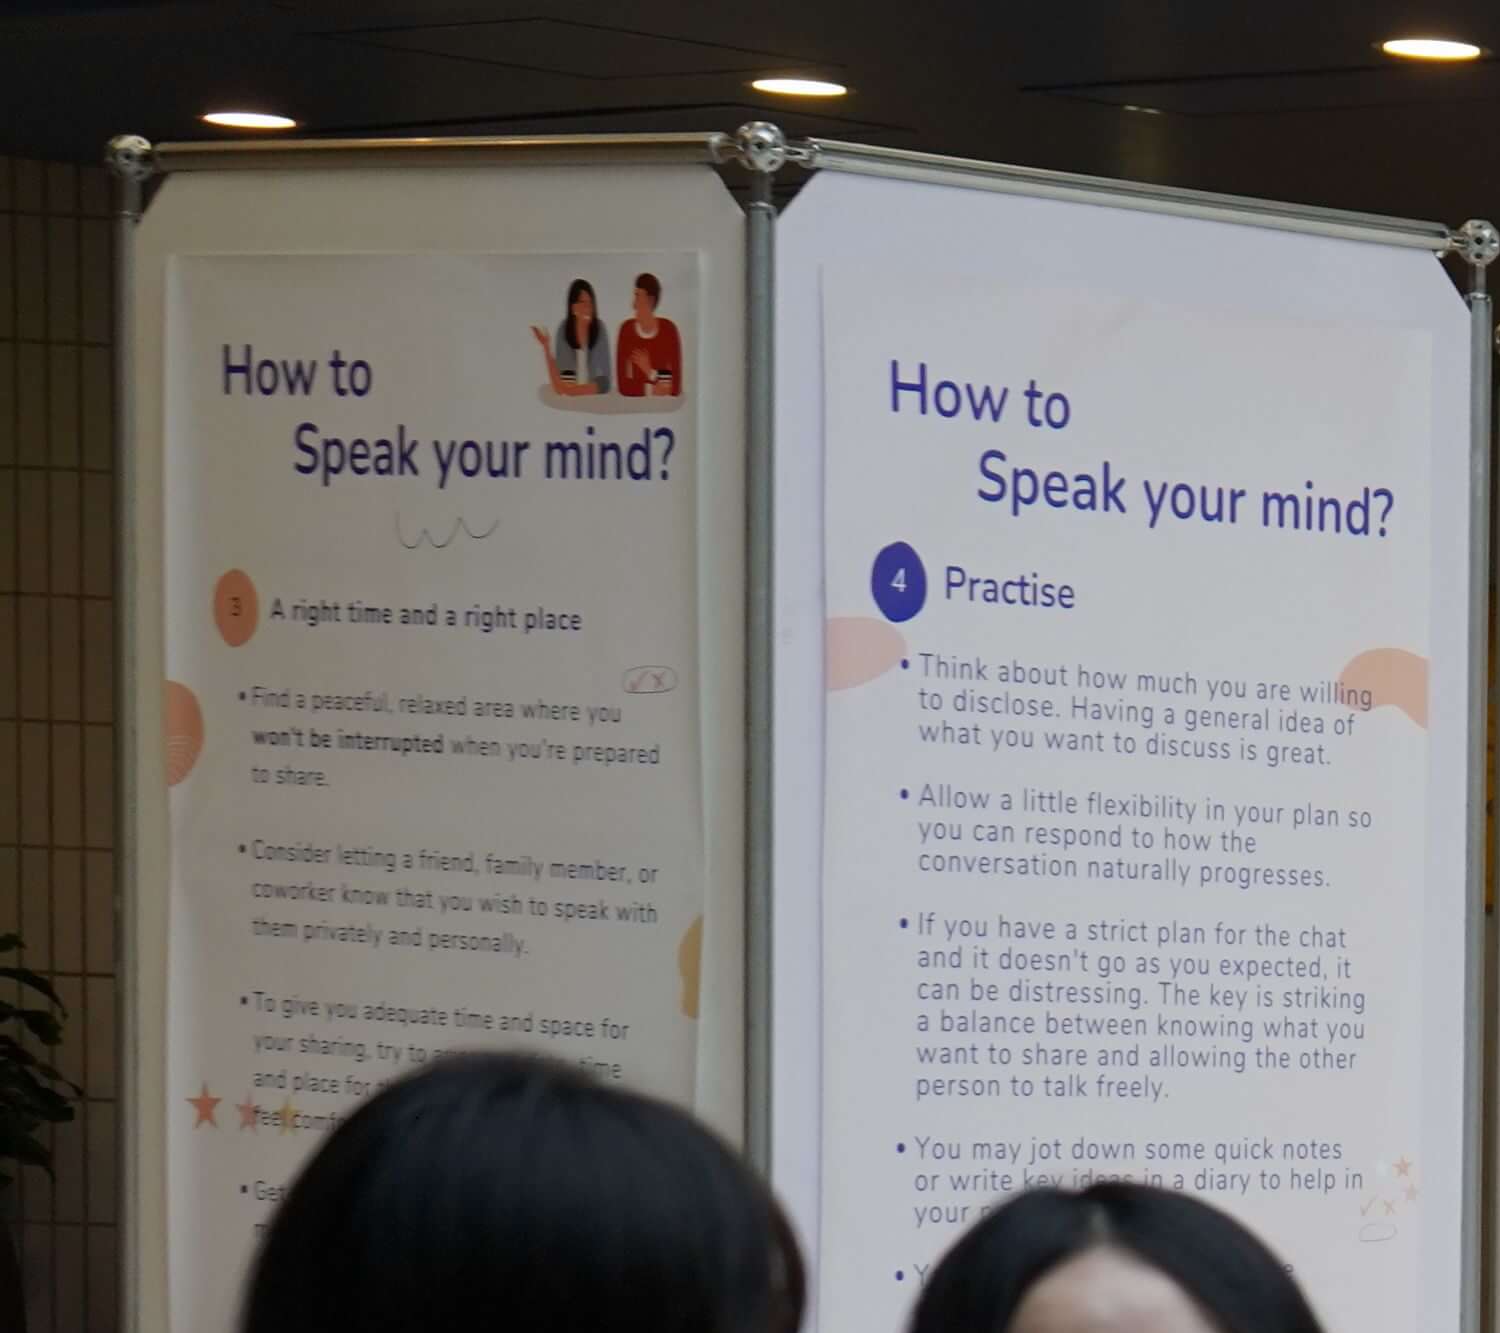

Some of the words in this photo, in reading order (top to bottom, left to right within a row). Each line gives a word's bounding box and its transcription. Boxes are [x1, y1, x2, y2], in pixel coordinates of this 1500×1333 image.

[224, 344, 316, 395] How
[328, 350, 372, 397] to
[891, 360, 1008, 422] How
[1024, 380, 1070, 429] to
[295, 423, 418, 486] Speak
[433, 440, 530, 489] your
[546, 426, 674, 480] mind?
[978, 450, 1126, 516] Speak
[1144, 480, 1246, 528] your
[1263, 480, 1393, 537] mind?
[891, 567, 908, 592] 4
[946, 566, 1074, 608] Practise
[271, 599, 285, 618] A
[293, 602, 341, 627] right
[347, 606, 392, 624] time
[400, 604, 437, 625] and
[446, 610, 456, 626] a
[465, 605, 517, 633] right
[525, 608, 581, 634] place
[918, 653, 988, 680] Think
[998, 660, 1068, 686] about
[1078, 664, 1127, 690] how
[1137, 672, 1196, 694] much
[1207, 680, 1246, 701] you
[1257, 683, 1290, 701] are
[1300, 682, 1373, 711] willing
